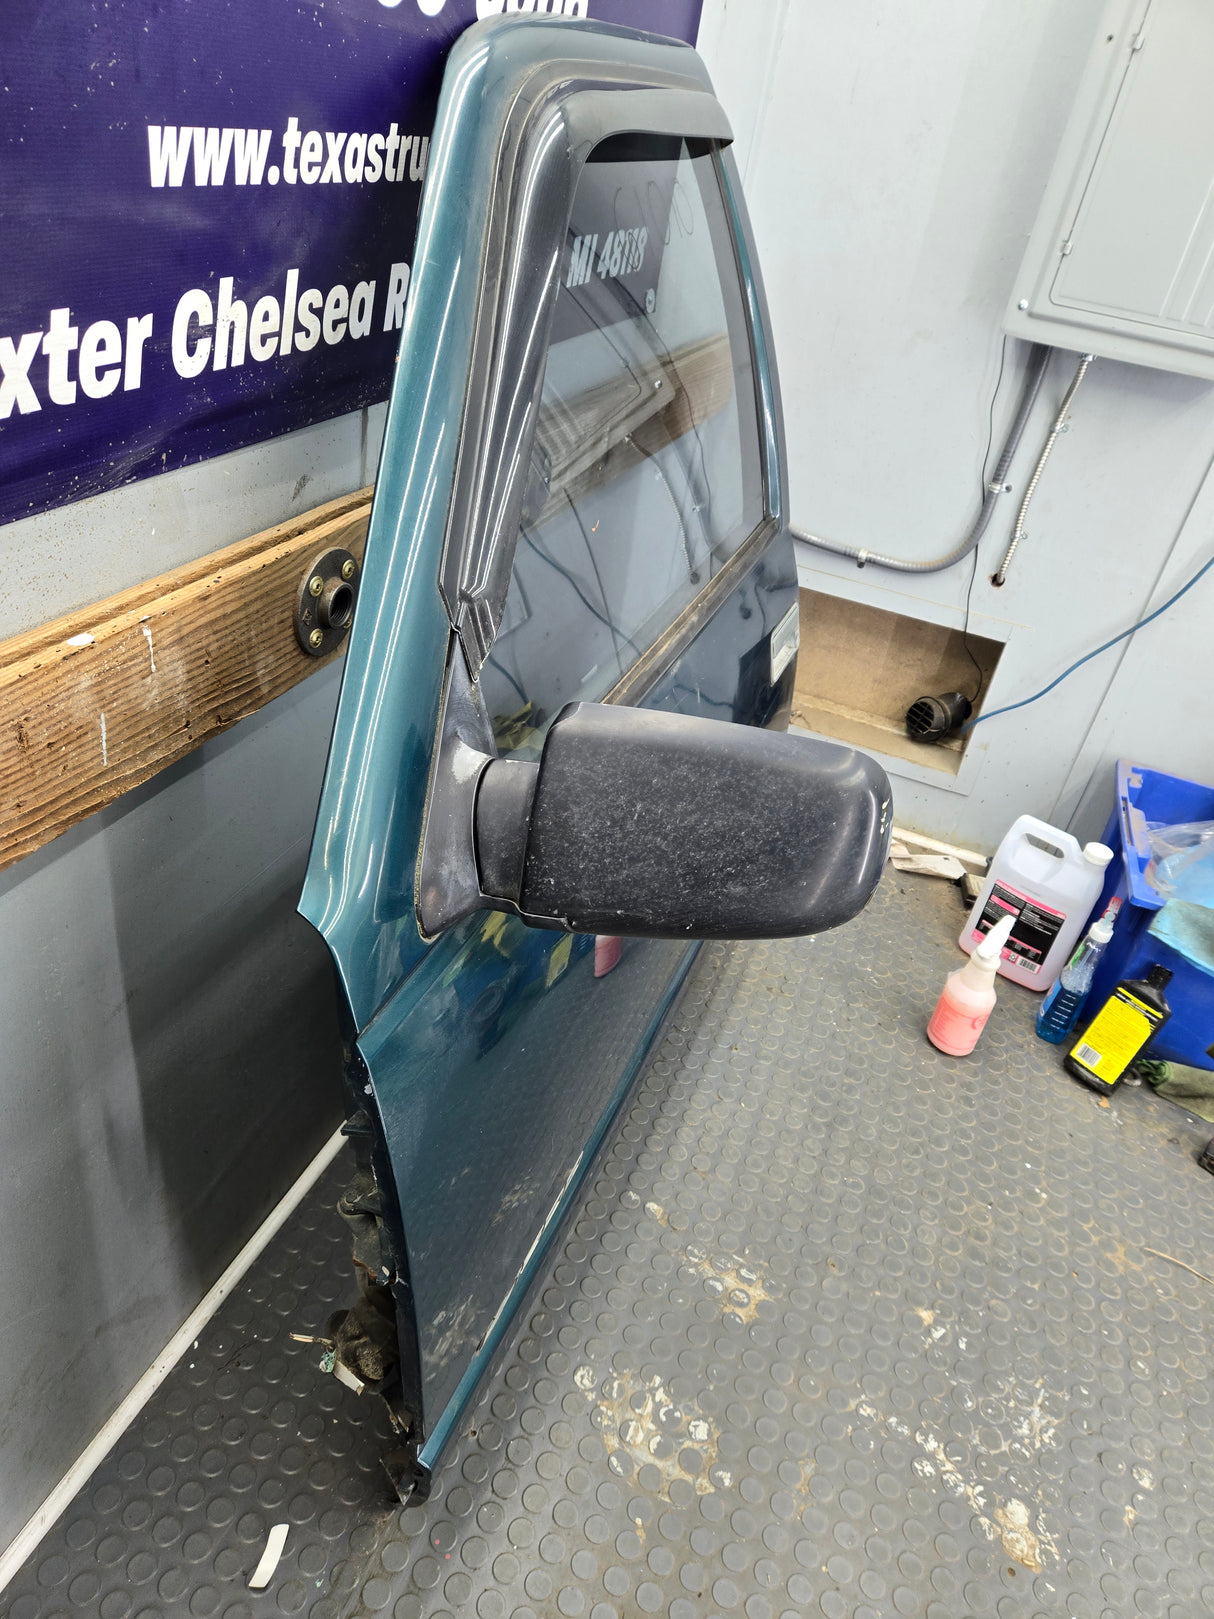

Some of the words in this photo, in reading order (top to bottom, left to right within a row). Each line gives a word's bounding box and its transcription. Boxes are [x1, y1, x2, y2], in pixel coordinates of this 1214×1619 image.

[147, 117, 430, 188] www.texastru
[171, 268, 376, 379] Chelsea
[566, 233, 599, 288] MI
